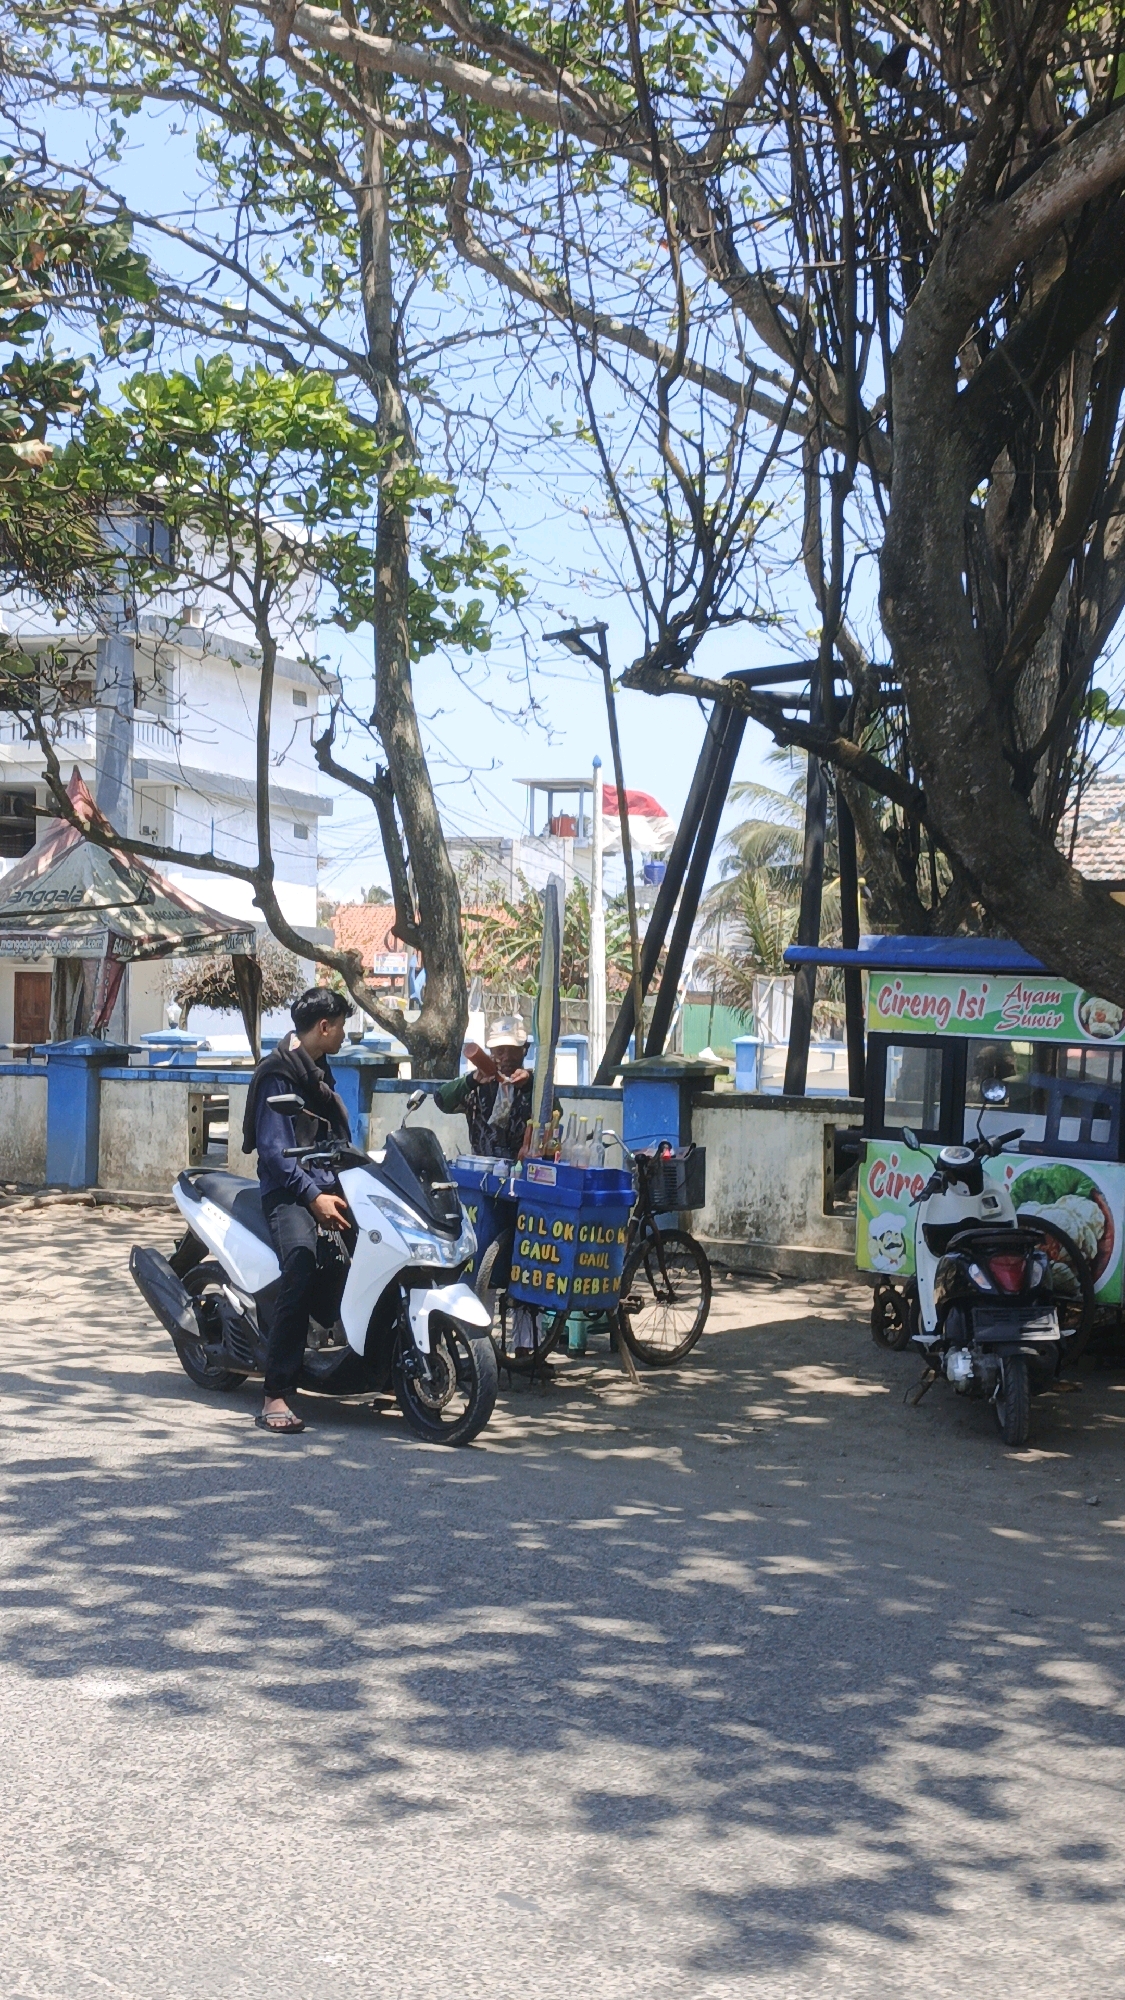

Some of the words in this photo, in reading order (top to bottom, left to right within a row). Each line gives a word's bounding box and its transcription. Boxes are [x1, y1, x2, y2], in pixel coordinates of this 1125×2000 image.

[878, 980, 951, 1027] Cireng
[956, 983, 988, 1019] Isi
[1002, 982, 1062, 1008] Ayam
[995, 1003, 1064, 1030] Suwir
[868, 1153, 925, 1200] Cire
[517, 1214, 575, 1241] CILOK
[579, 1225, 626, 1244] CILOK
[520, 1239, 560, 1262] GAUL
[579, 1252, 609, 1269] GAUL
[510, 1265, 568, 1295] BEBEN
[573, 1277, 621, 1295] BEBEN
